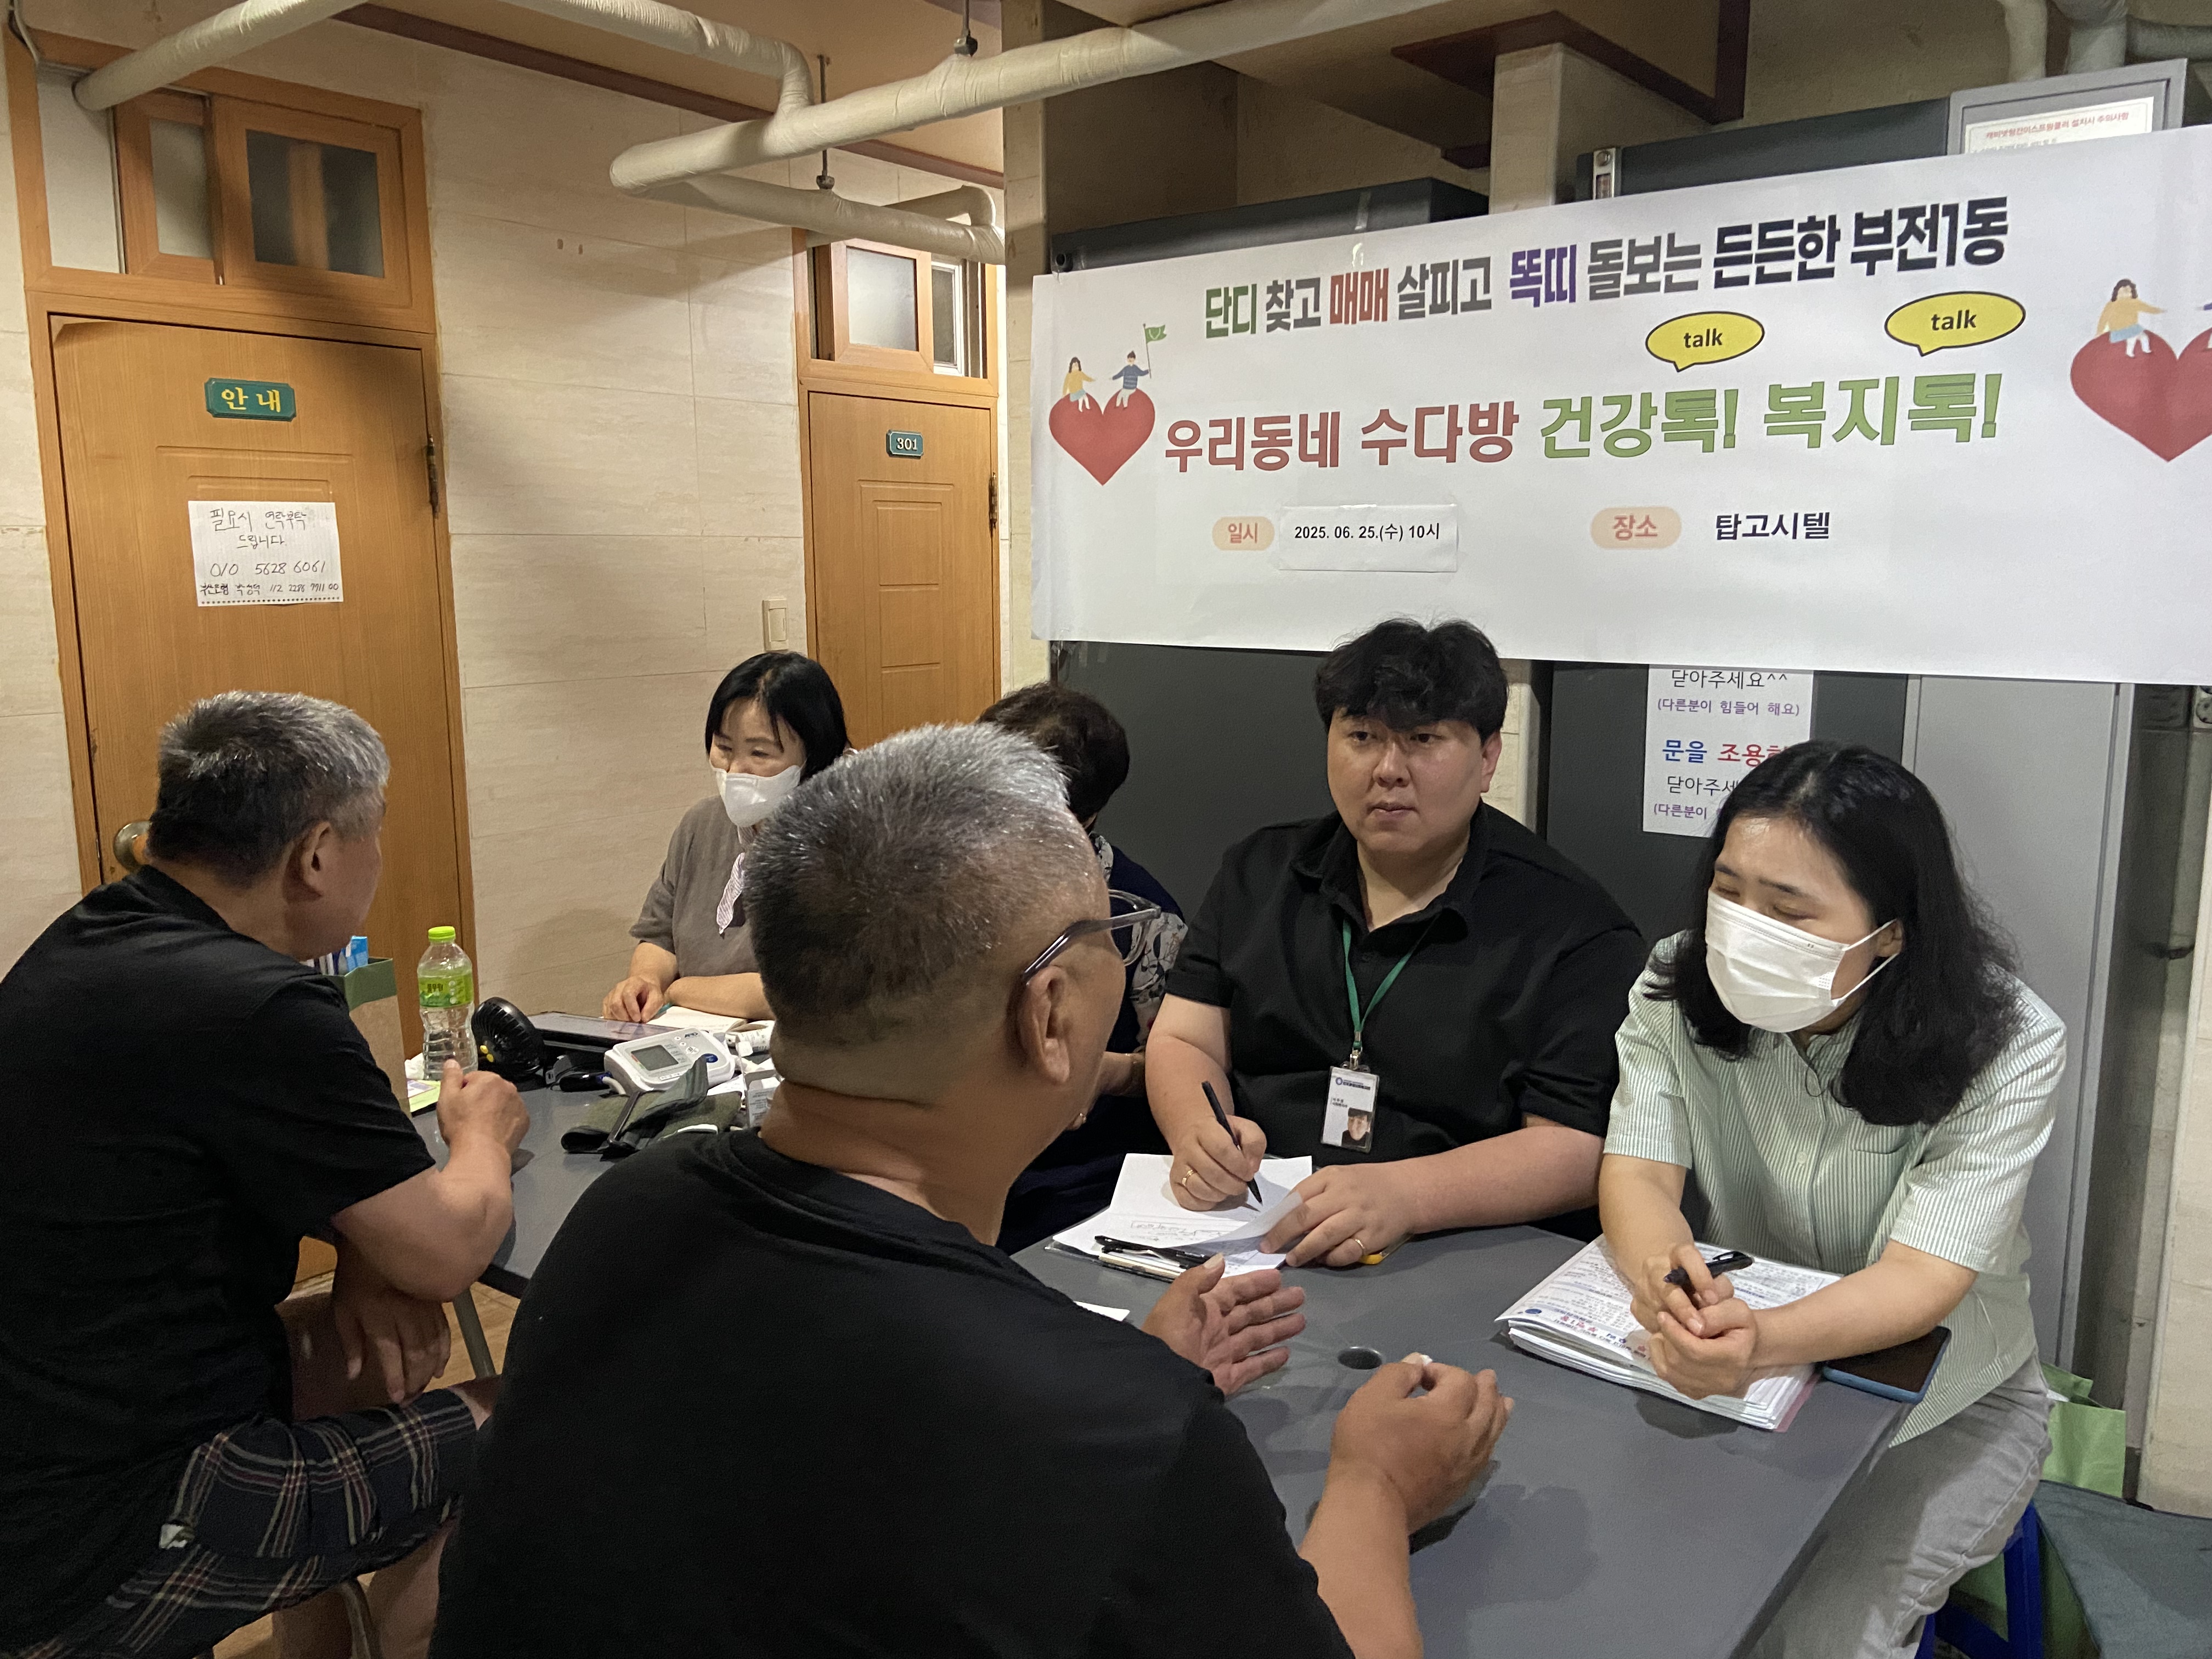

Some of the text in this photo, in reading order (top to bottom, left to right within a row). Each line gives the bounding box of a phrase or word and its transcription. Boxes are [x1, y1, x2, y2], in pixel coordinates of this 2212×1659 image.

[1205, 196, 2008, 338] 단디 찾고 매매 살피고 똑띠 돌보는 든든한 부전1동
[1931, 310, 1977, 331] talk
[1683, 329, 1723, 348] talk
[1165, 373, 2002, 473] 우리동네 수다방 건강톡! 복지톡!
[896, 437, 917, 450] 301
[210, 507, 307, 532] 필요시 연락부탁
[1613, 514, 1658, 541] 장소
[1716, 512, 1830, 540] 탑고시텔
[1228, 523, 1258, 544] 일시
[1295, 523, 1440, 542] 2025. 06. 25.(수) 10시
[210, 560, 325, 577] 010 5628 6061
[269, 584, 283, 592] 112
[1657, 698, 1800, 716] (다른분이 힘들어 해요)
[1662, 740, 1708, 764] 문을
[1654, 803, 1707, 820] (다른분이
